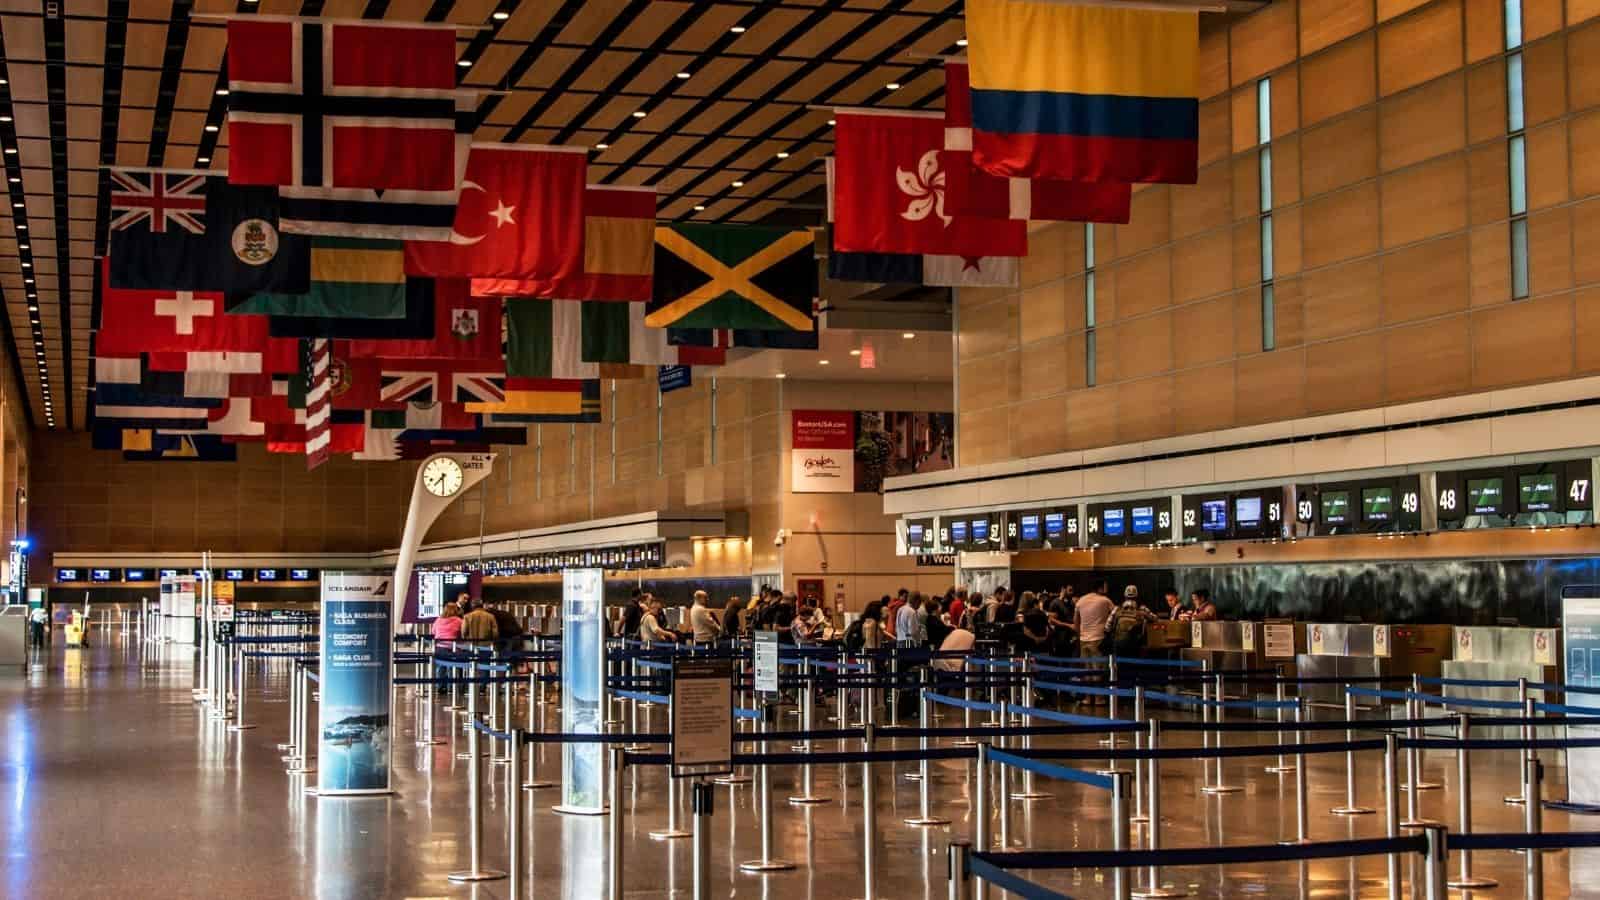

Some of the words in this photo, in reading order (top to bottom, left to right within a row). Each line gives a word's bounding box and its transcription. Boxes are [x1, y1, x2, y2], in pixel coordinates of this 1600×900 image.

[1569, 479, 1589, 502] 47
[1402, 492, 1417, 512] 49
[1440, 489, 1456, 510] 48
[1183, 509, 1196, 526] 52
[1269, 503, 1281, 521] 51
[1298, 501, 1312, 519] 50
[1067, 518, 1077, 533] 55
[1088, 516, 1099, 533] 54
[1158, 511, 1170, 528] 53
[1008, 522, 1017, 537] 56
